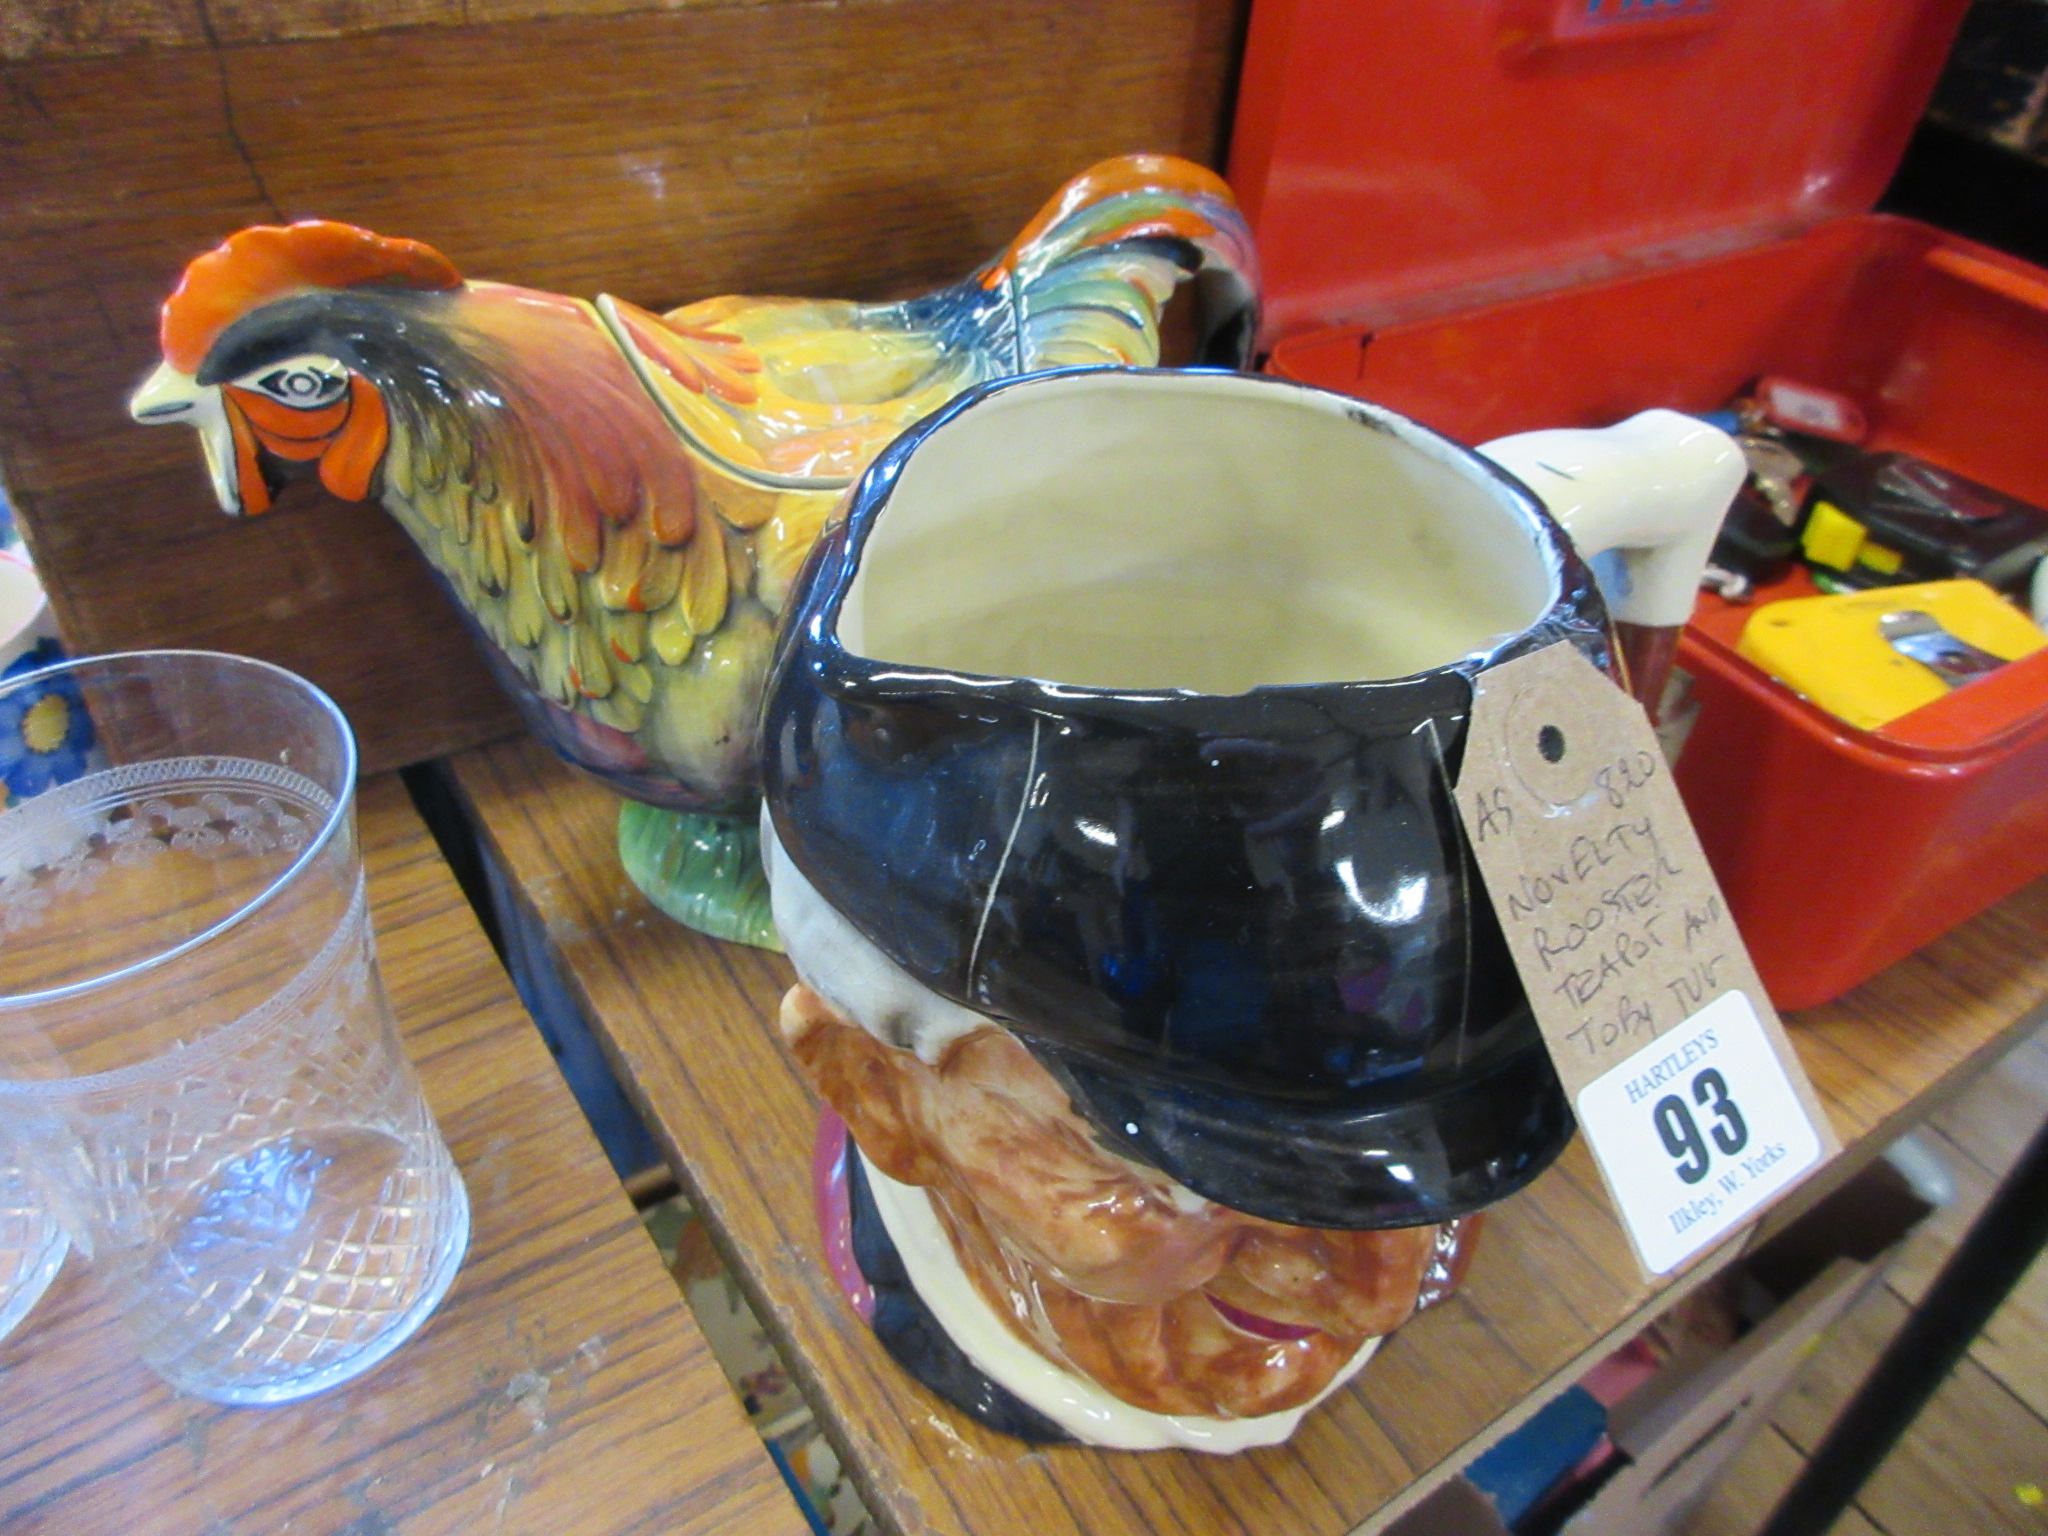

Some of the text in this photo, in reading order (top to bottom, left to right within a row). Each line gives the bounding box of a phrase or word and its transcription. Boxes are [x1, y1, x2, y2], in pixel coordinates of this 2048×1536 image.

[1553, 911, 1667, 1010] TEAPOT
[1623, 1028, 1720, 1104] HARTLEYS
[1652, 1066, 1750, 1185] 93
[1667, 1142, 1788, 1235] Ilkley, W. Yorks
